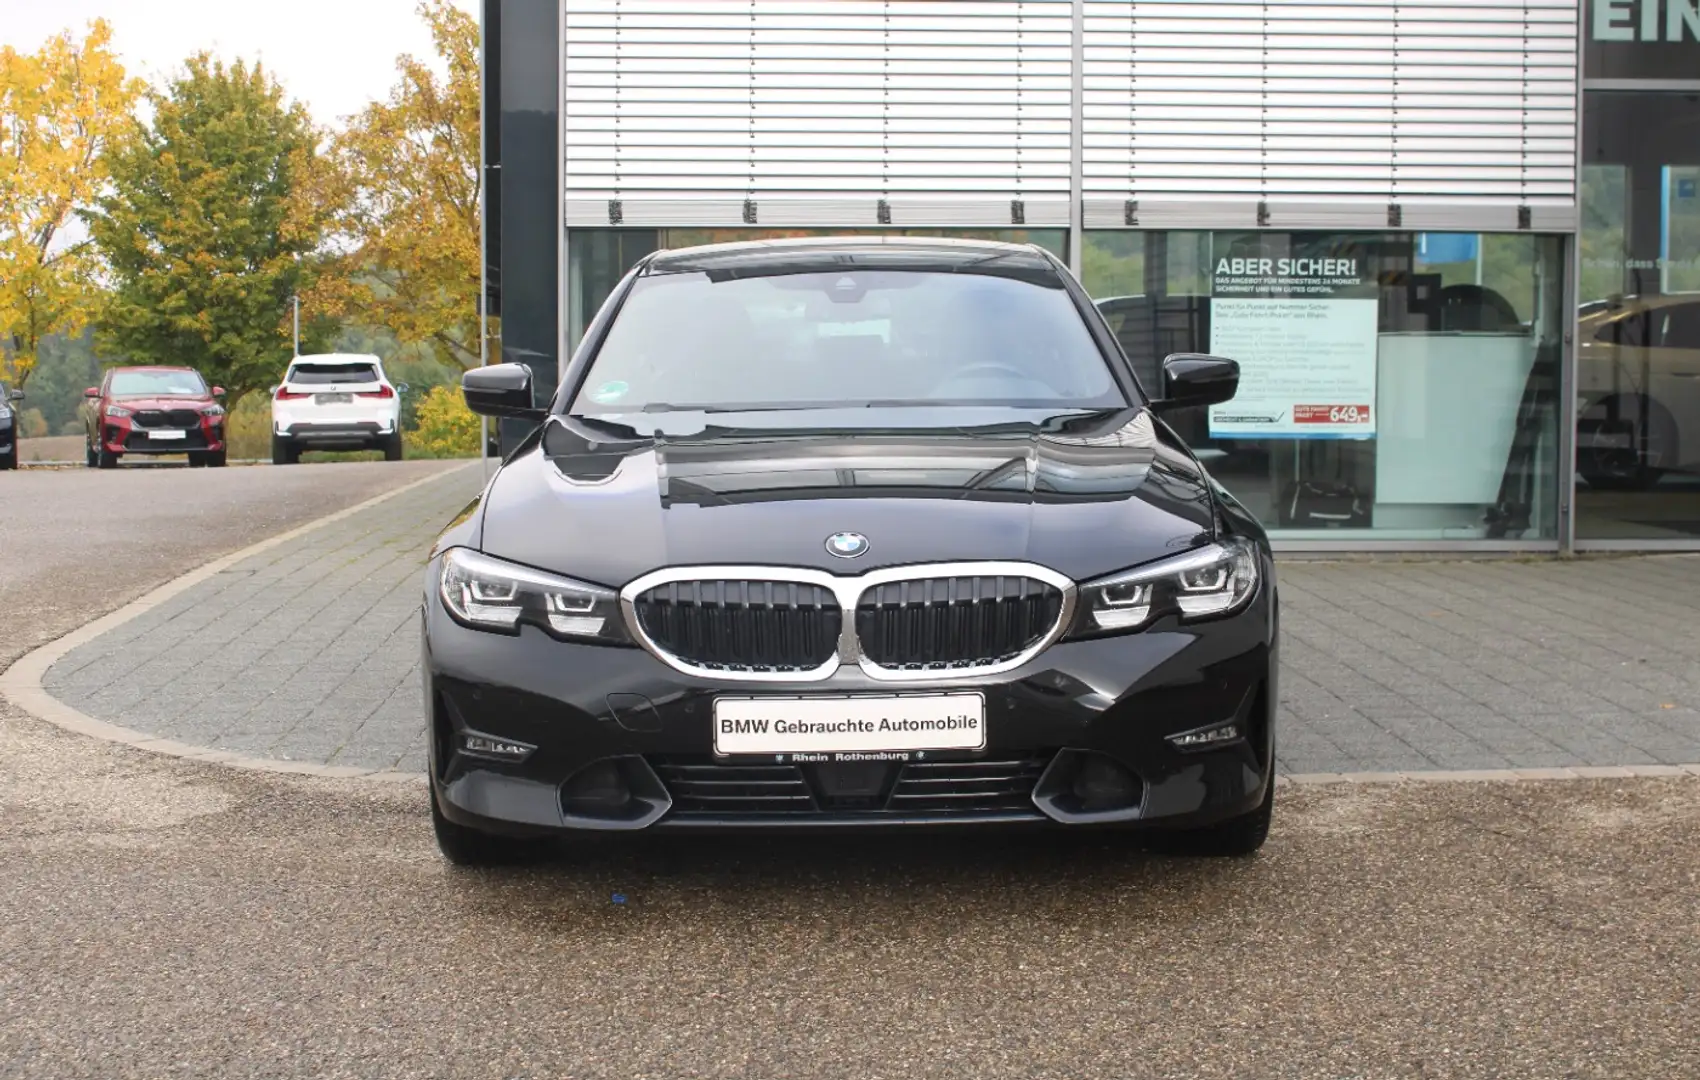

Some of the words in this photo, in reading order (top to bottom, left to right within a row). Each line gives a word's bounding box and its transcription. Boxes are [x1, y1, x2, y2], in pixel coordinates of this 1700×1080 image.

[1216, 258, 1272, 275] ABER
[1277, 258, 1356, 276] SICHER!
[1625, 257, 1654, 269] dass
[1264, 276, 1277, 284] FÜR
[1255, 285, 1270, 293] UND
[721, 718, 768, 734] BMW
[774, 718, 874, 734] Gebrauchte
[878, 714, 978, 732] Automobile
[791, 753, 829, 762] Rhein
[835, 751, 909, 762] Rothenburg
